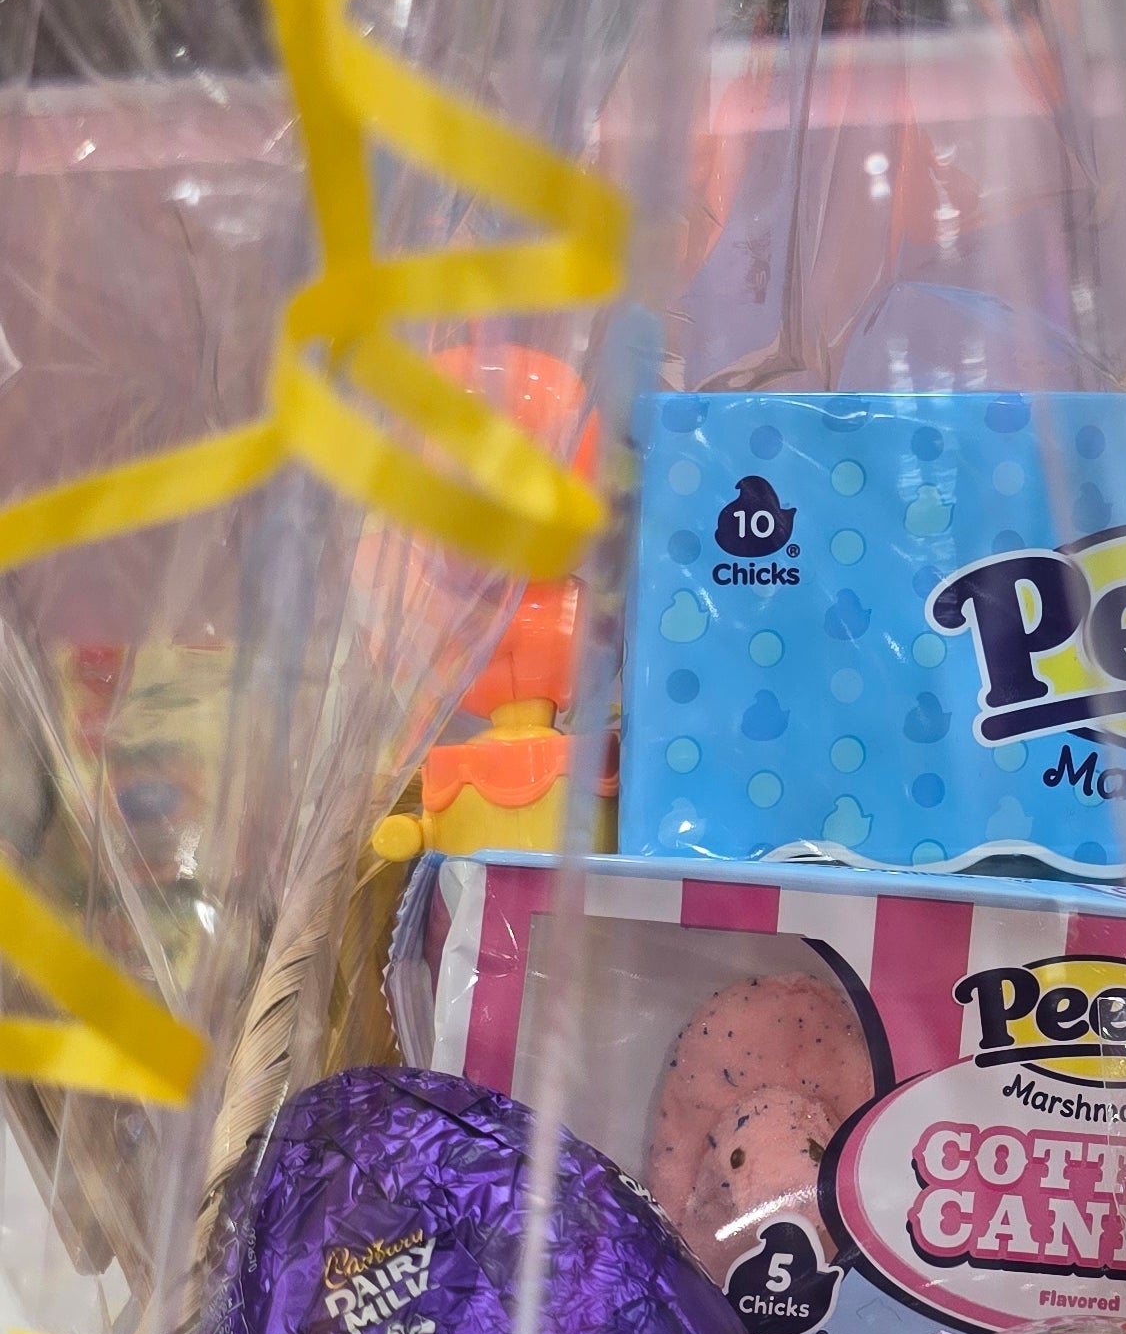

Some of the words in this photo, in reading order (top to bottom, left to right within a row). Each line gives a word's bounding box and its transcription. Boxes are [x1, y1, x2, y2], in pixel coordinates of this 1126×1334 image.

[733, 510, 775, 538] 10
[712, 563, 800, 586] Chicks
[324, 1229, 425, 1289] Cadbury
[325, 1238, 437, 1319] DAIRY
[766, 1254, 792, 1293] 5
[738, 1294, 810, 1319] Chicks
[1039, 1290, 1121, 1312] Flavored
